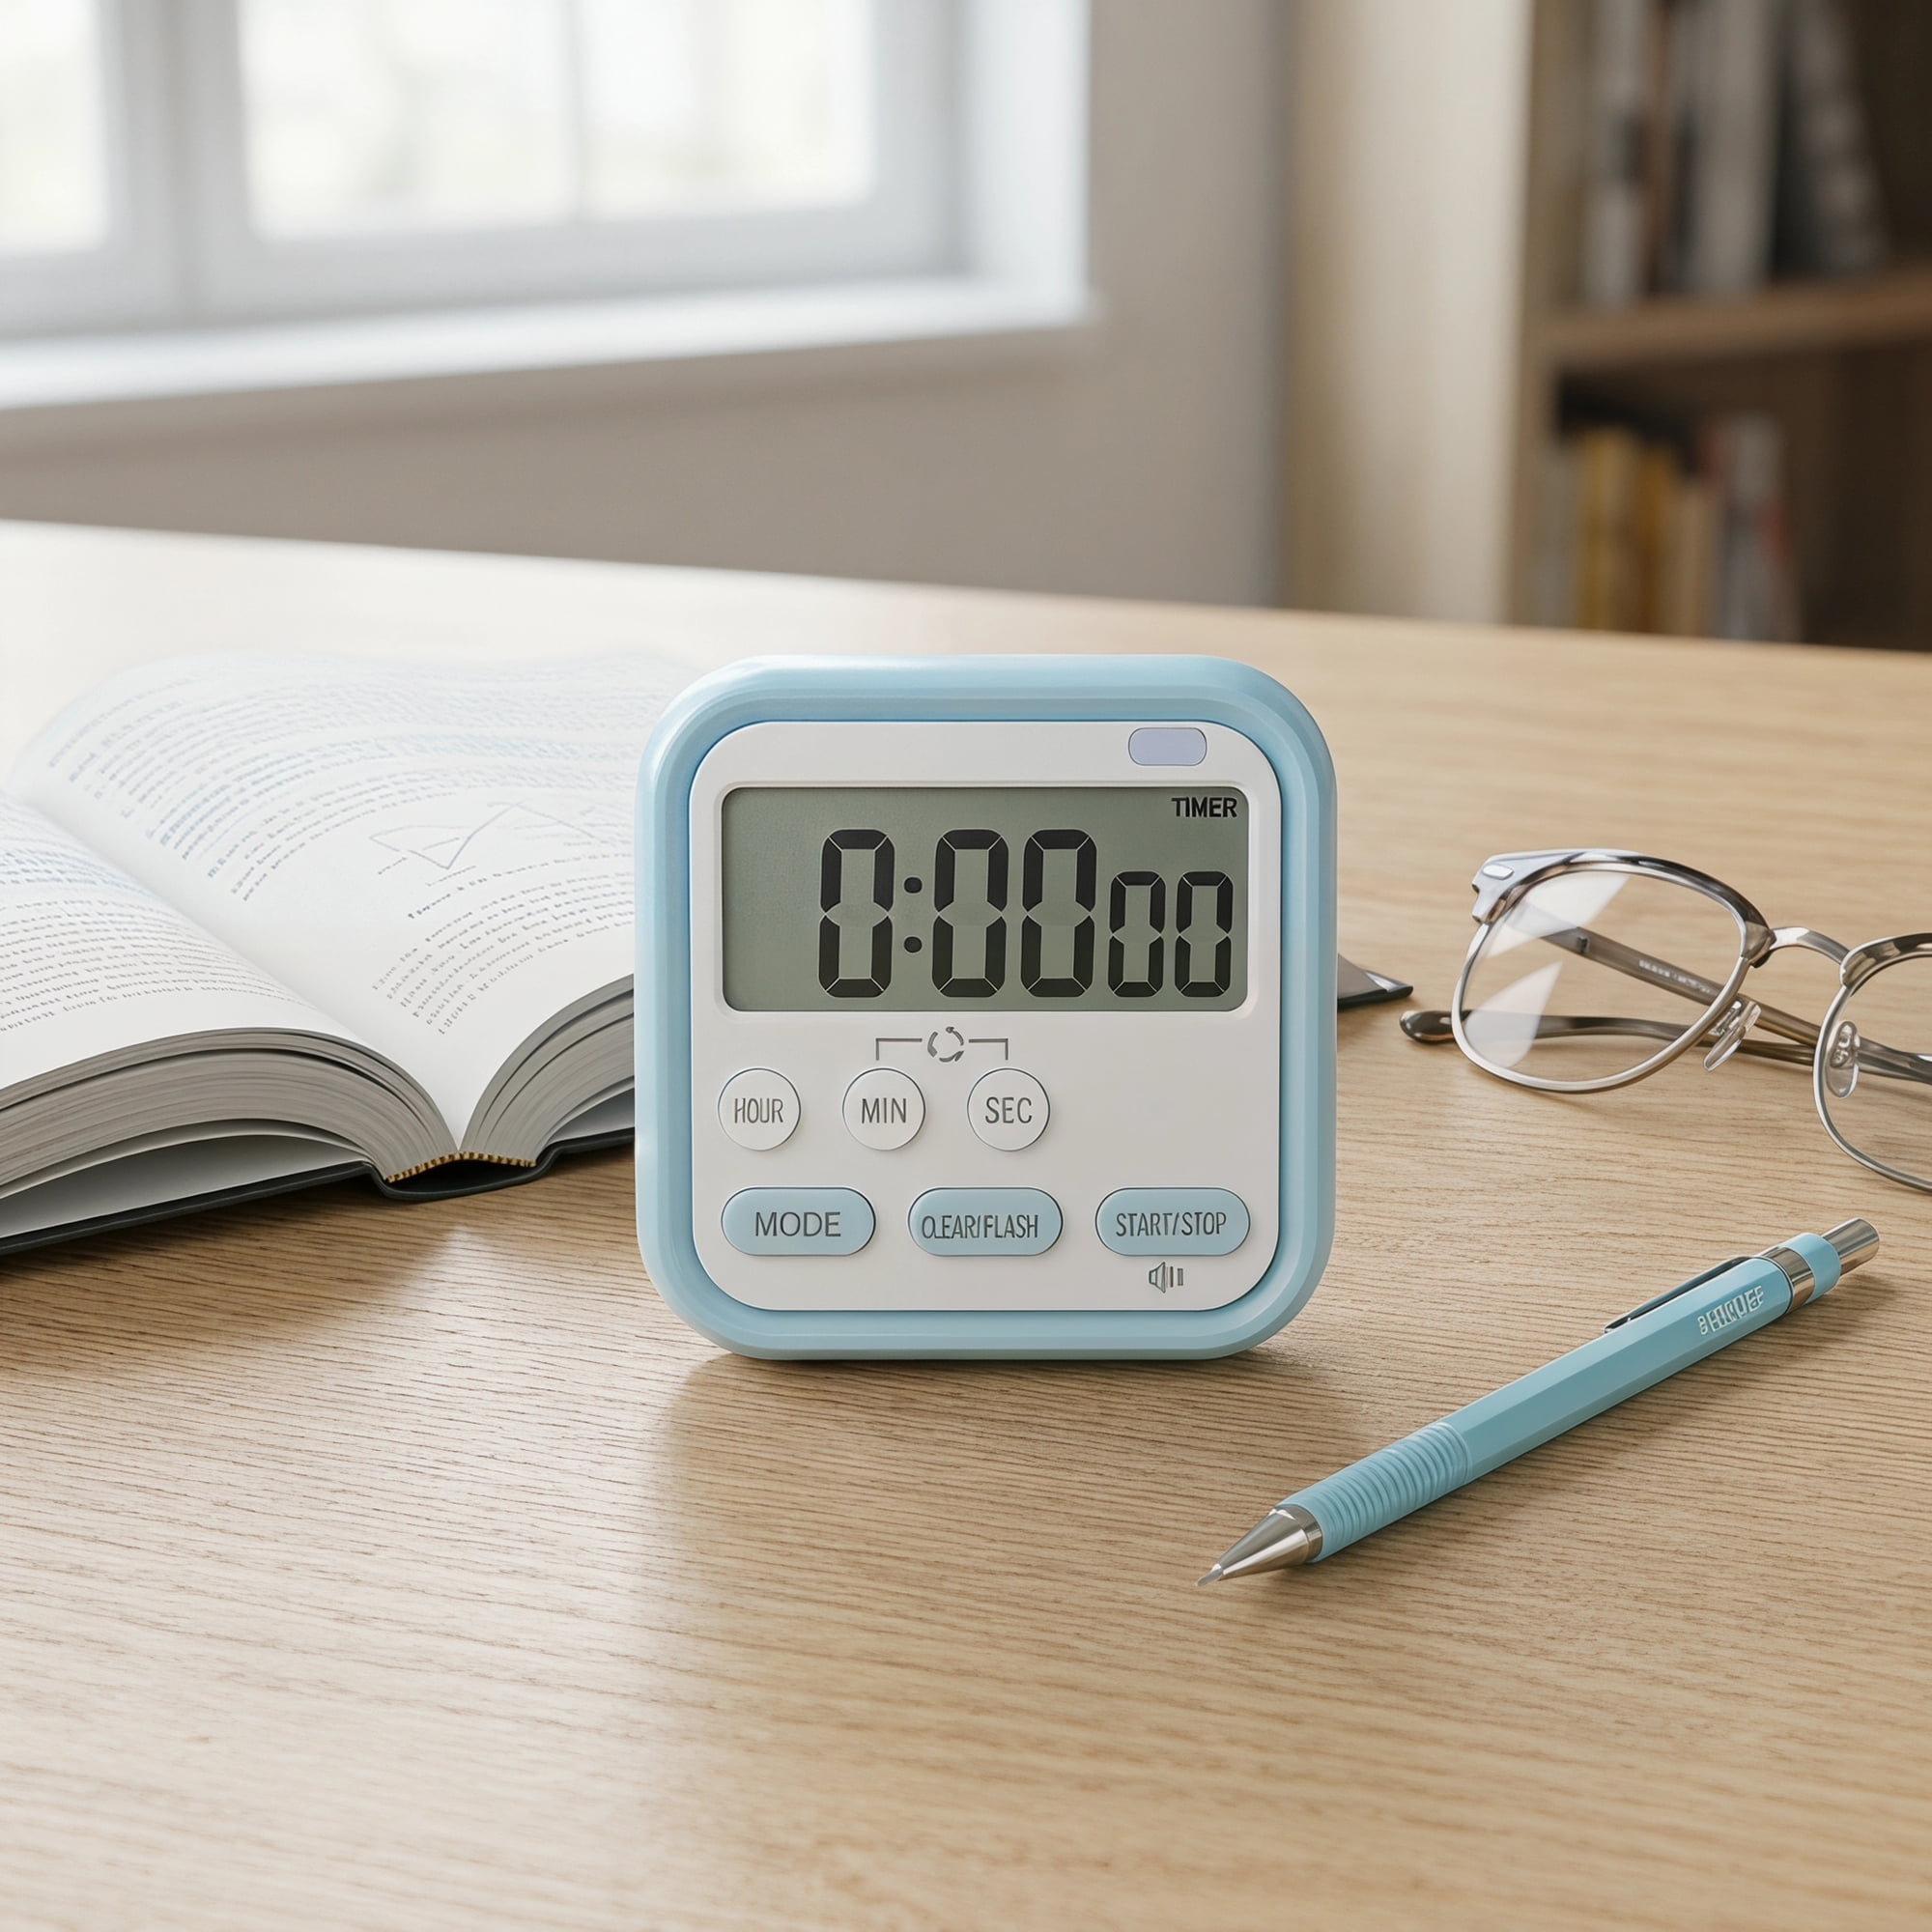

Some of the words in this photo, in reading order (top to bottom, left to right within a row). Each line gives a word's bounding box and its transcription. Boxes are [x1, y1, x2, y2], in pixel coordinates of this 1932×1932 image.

[1171, 797, 1237, 817] TIMER
[734, 1097, 783, 1123] HOUR
[861, 1097, 907, 1123] MIN
[984, 1097, 1033, 1123] SEC
[754, 1211, 841, 1236] MODE
[1115, 1211, 1227, 1236] START/STOP
